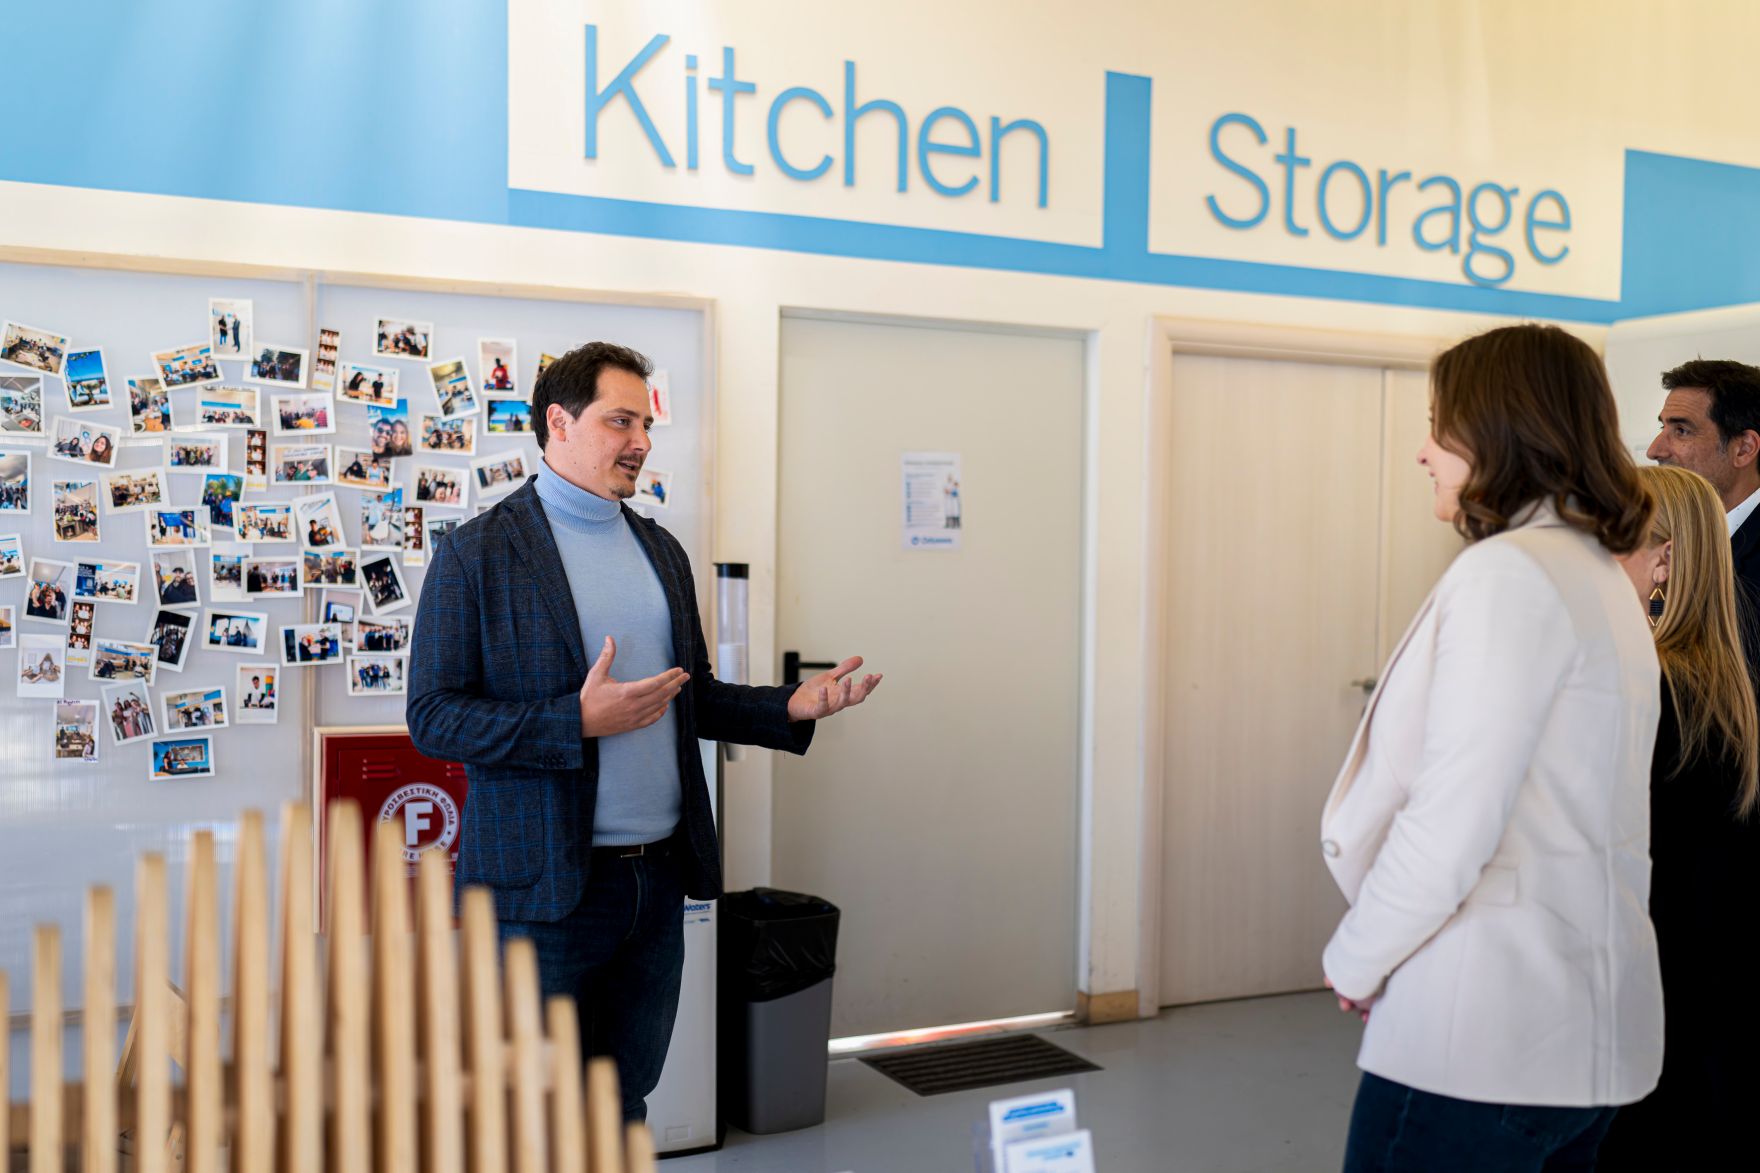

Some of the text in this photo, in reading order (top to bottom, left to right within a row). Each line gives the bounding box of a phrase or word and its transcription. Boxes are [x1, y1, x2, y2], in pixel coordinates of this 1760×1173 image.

[584, 24, 1049, 209] Kitchen
[1205, 112, 1572, 286] Storage
[382, 787, 439, 824] ΥΡΟΣΒΕΣΤΙΚΗ
[405, 801, 433, 846] F
